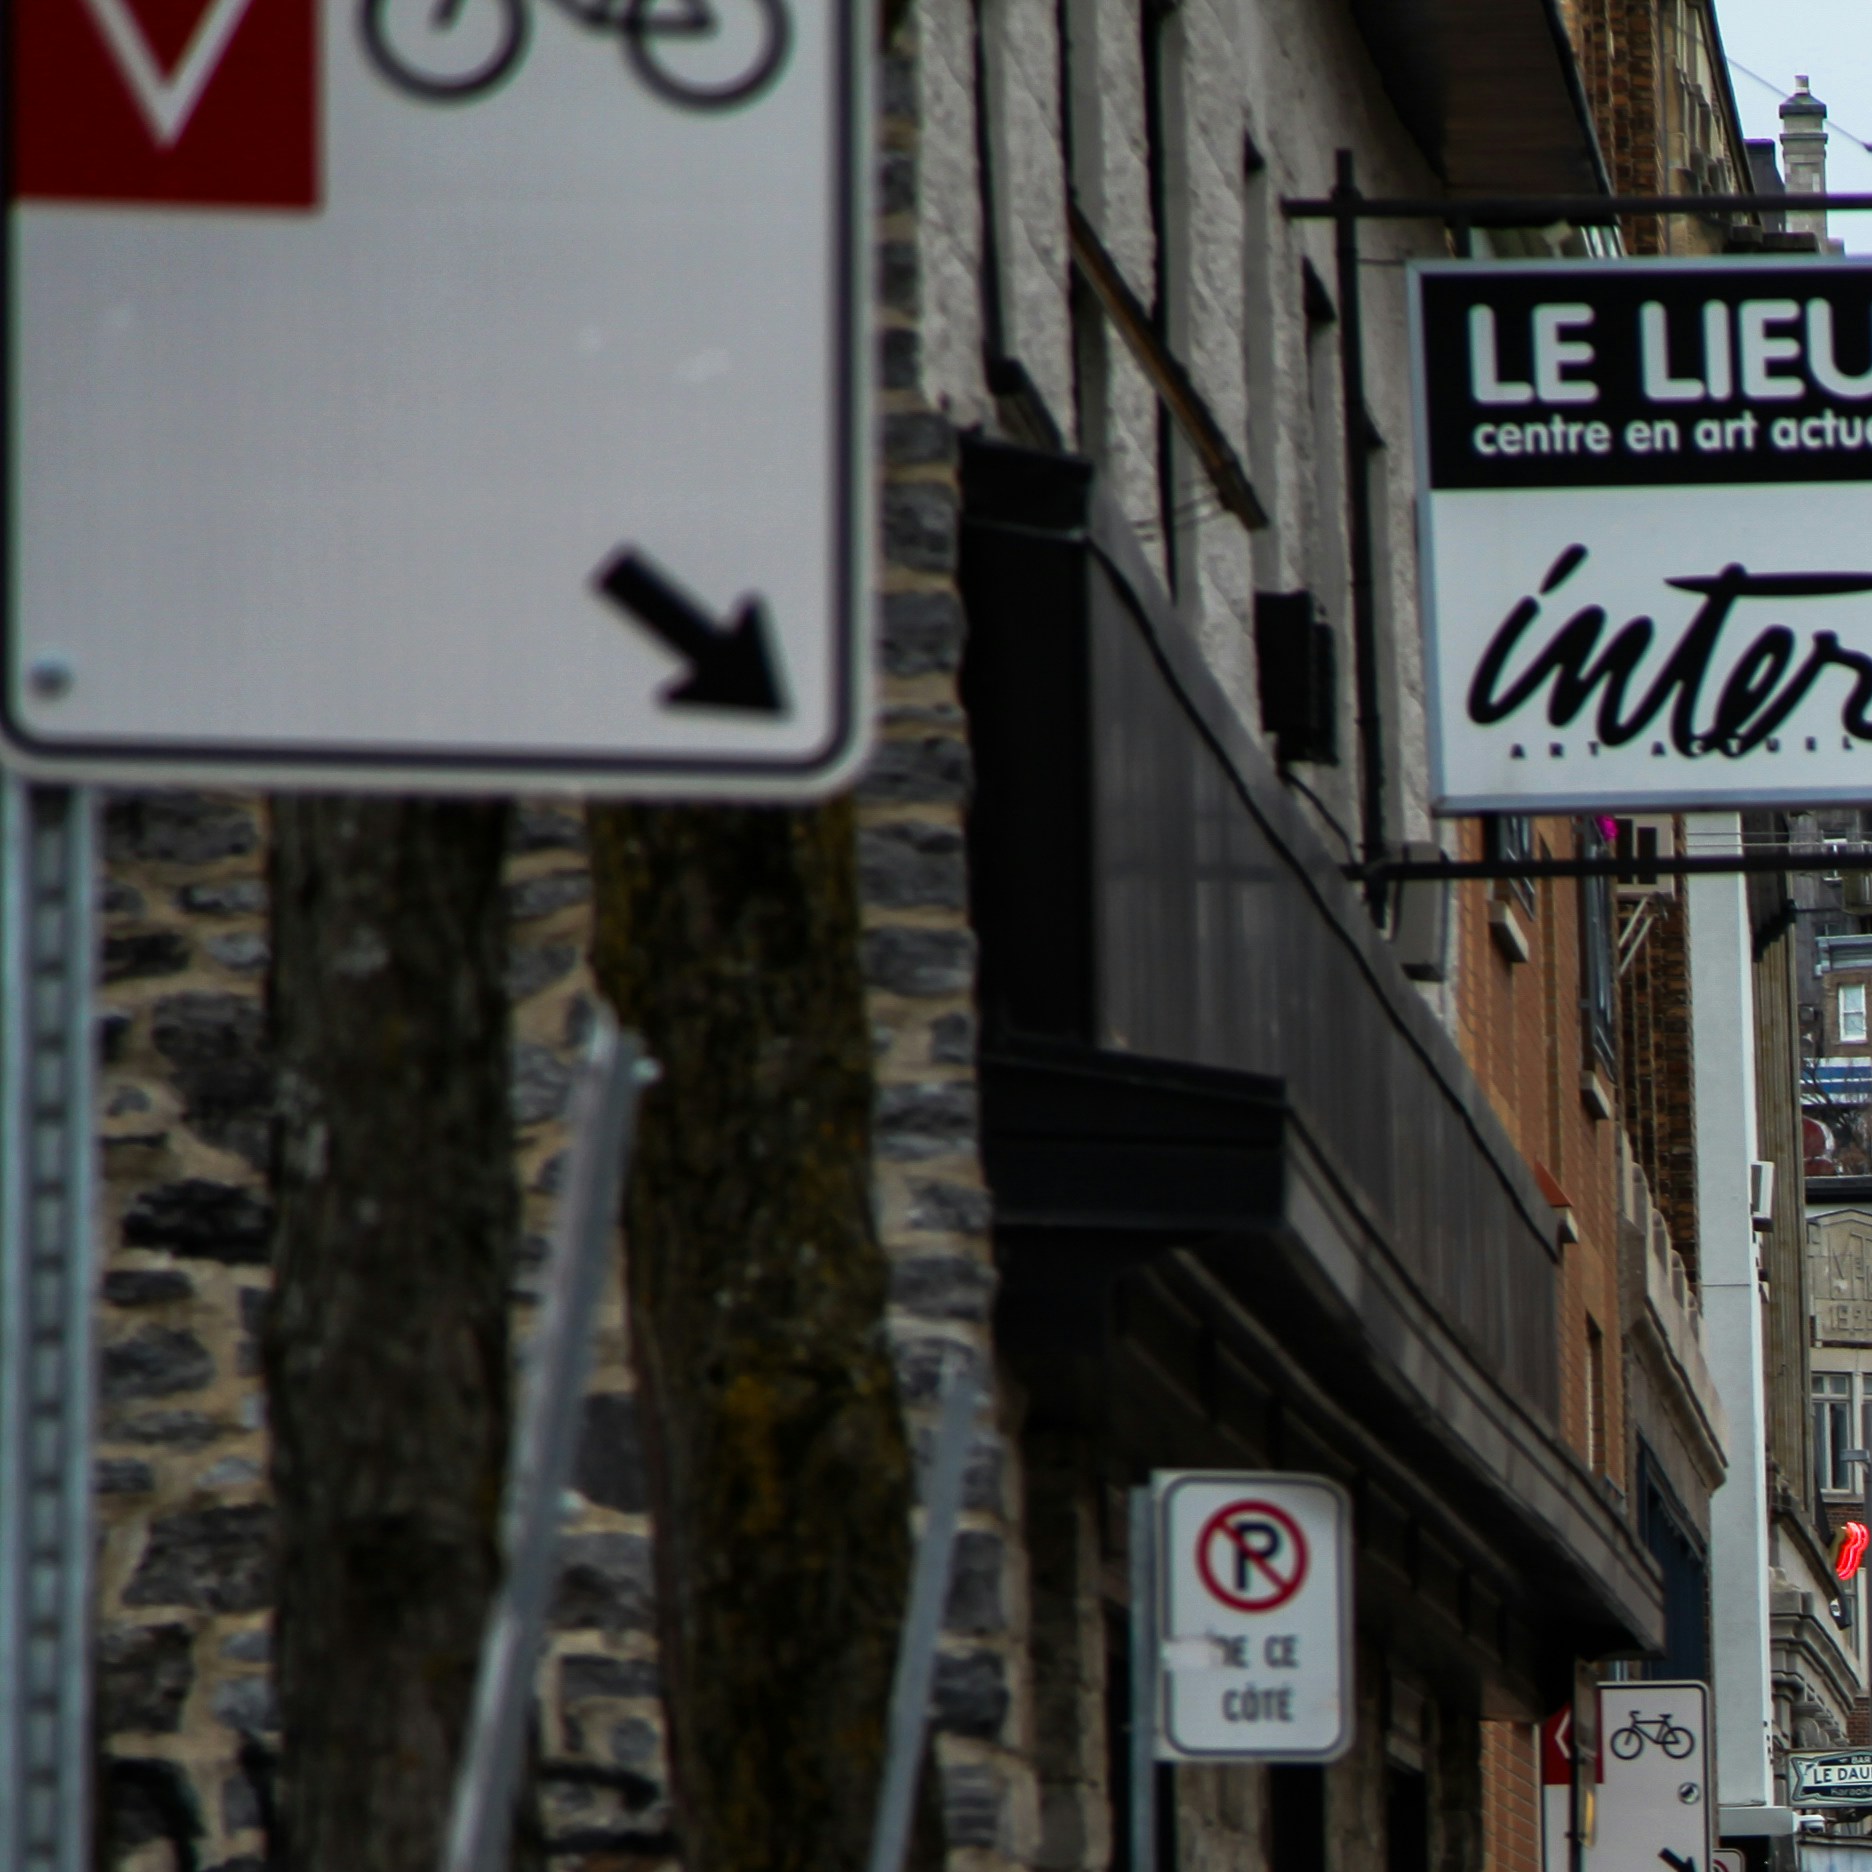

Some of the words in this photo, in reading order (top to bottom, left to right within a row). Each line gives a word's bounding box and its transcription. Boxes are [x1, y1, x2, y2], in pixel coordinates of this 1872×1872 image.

[1468, 303, 1599, 404] LE
[1473, 414, 1612, 455] centre
[1625, 419, 1679, 452] en
[1694, 410, 1767, 452] art
[1510, 740, 1603, 760] ART
[1263, 1633, 1299, 1669] CE
[1851, 1756, 1871, 1764] BAR
[1813, 1768, 1832, 1784] LE
